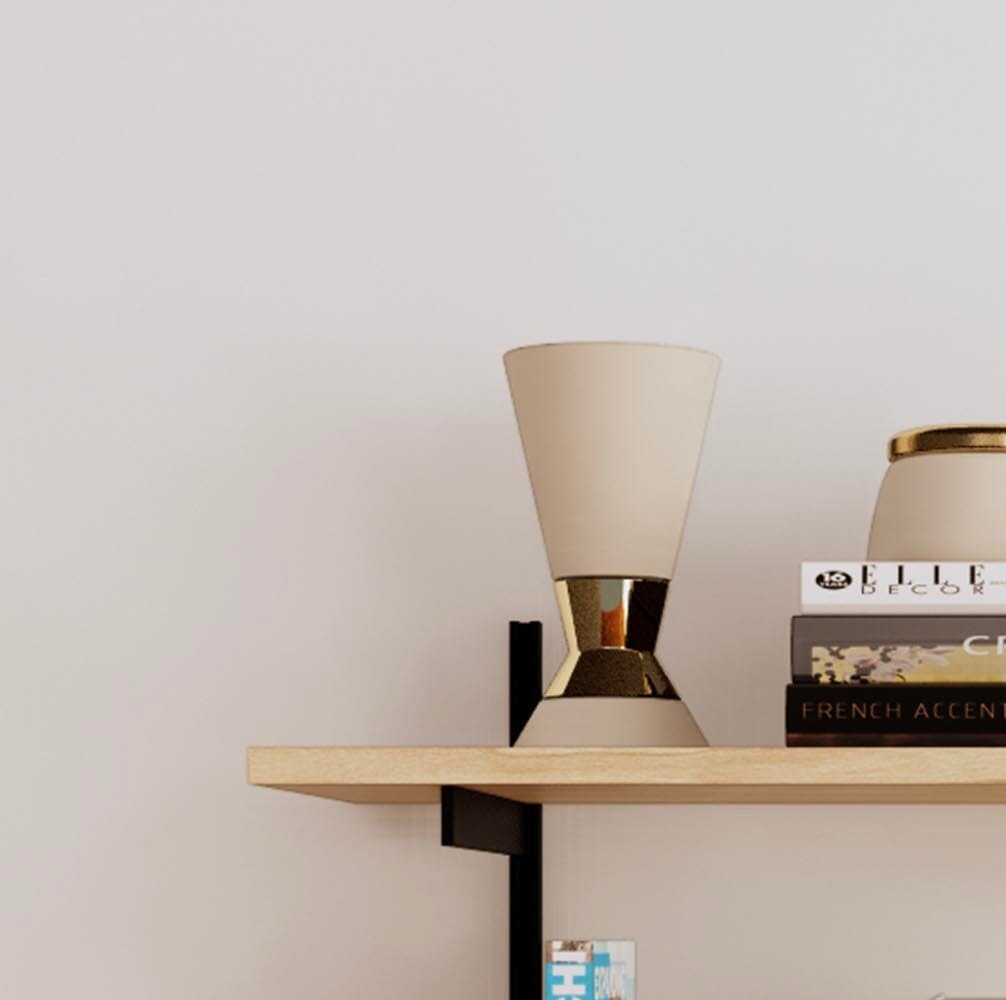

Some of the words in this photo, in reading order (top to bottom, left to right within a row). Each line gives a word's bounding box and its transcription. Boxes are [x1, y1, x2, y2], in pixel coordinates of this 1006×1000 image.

[861, 565, 984, 585] ELLE
[861, 584, 984, 595] DECOR
[802, 702, 901, 719] FRENCH
